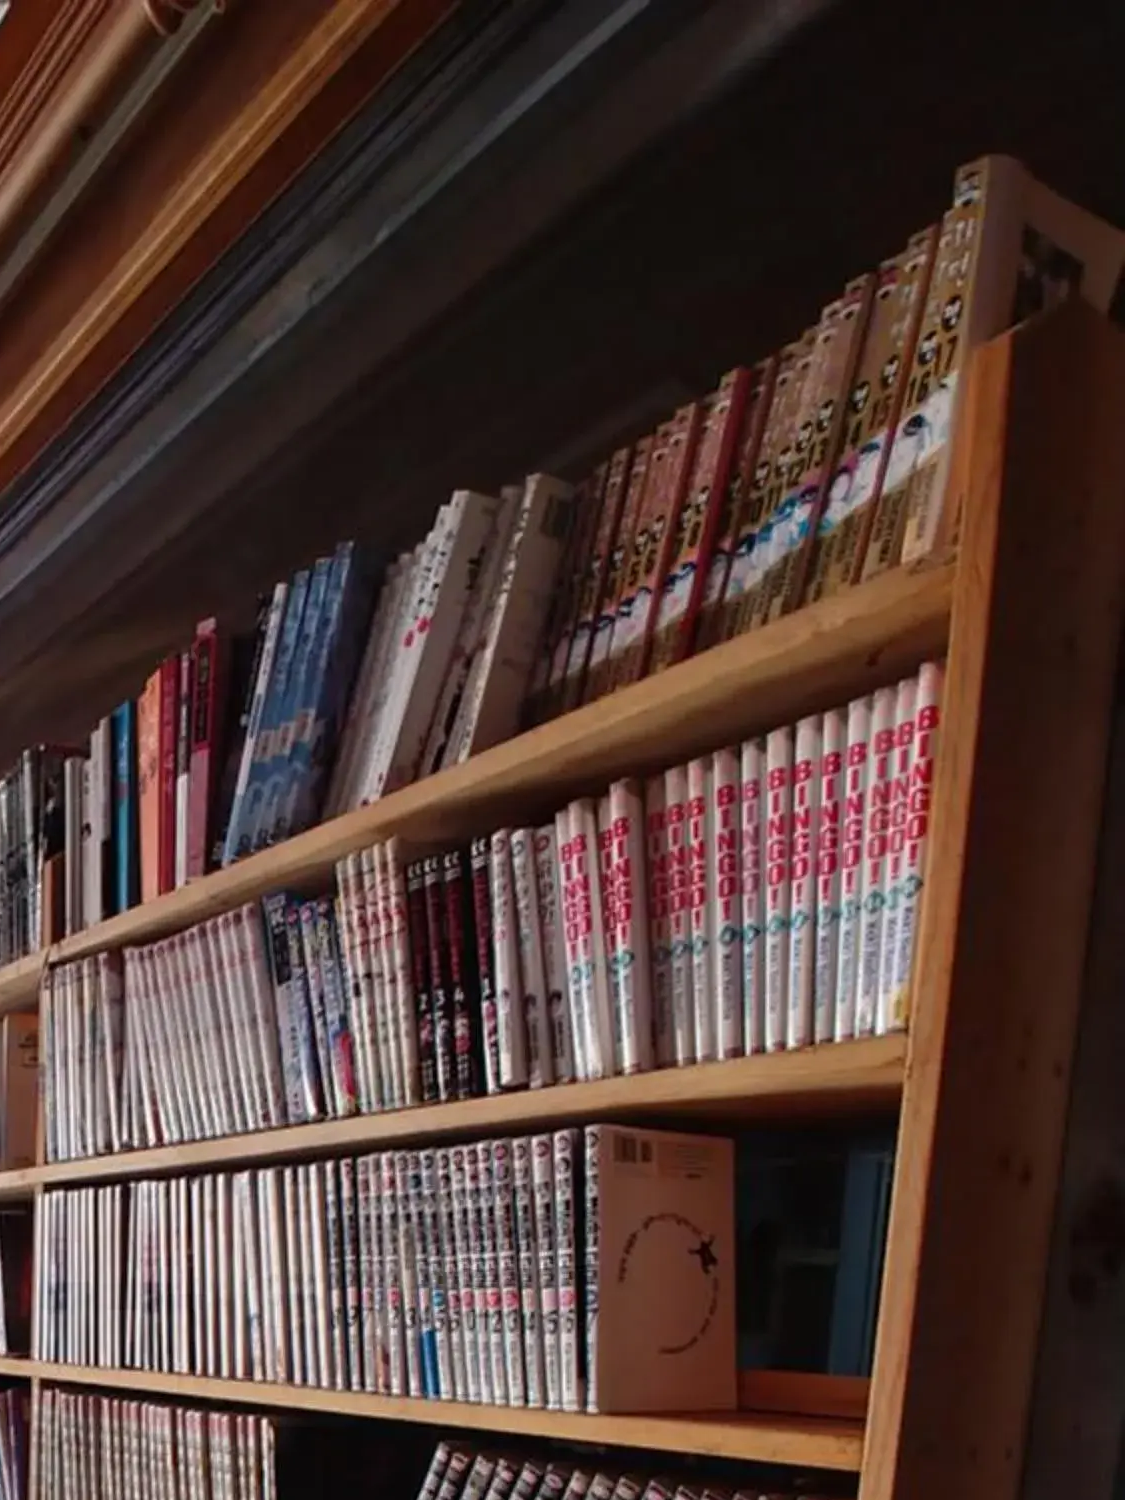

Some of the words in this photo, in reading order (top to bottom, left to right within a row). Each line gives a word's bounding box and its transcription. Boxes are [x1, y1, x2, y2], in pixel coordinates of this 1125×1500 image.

[933, 334, 959, 377] 17
[717, 784, 739, 922] BINGO!
[766, 766, 788, 910] BINGO!
[791, 760, 813, 904] BINGO!
[819, 750, 841, 899] BINGO!
[842, 741, 867, 894] BINGO!
[866, 728, 893, 885] BINGO!
[889, 720, 915, 880] BINGO!
[905, 704, 940, 868] BINGO!
